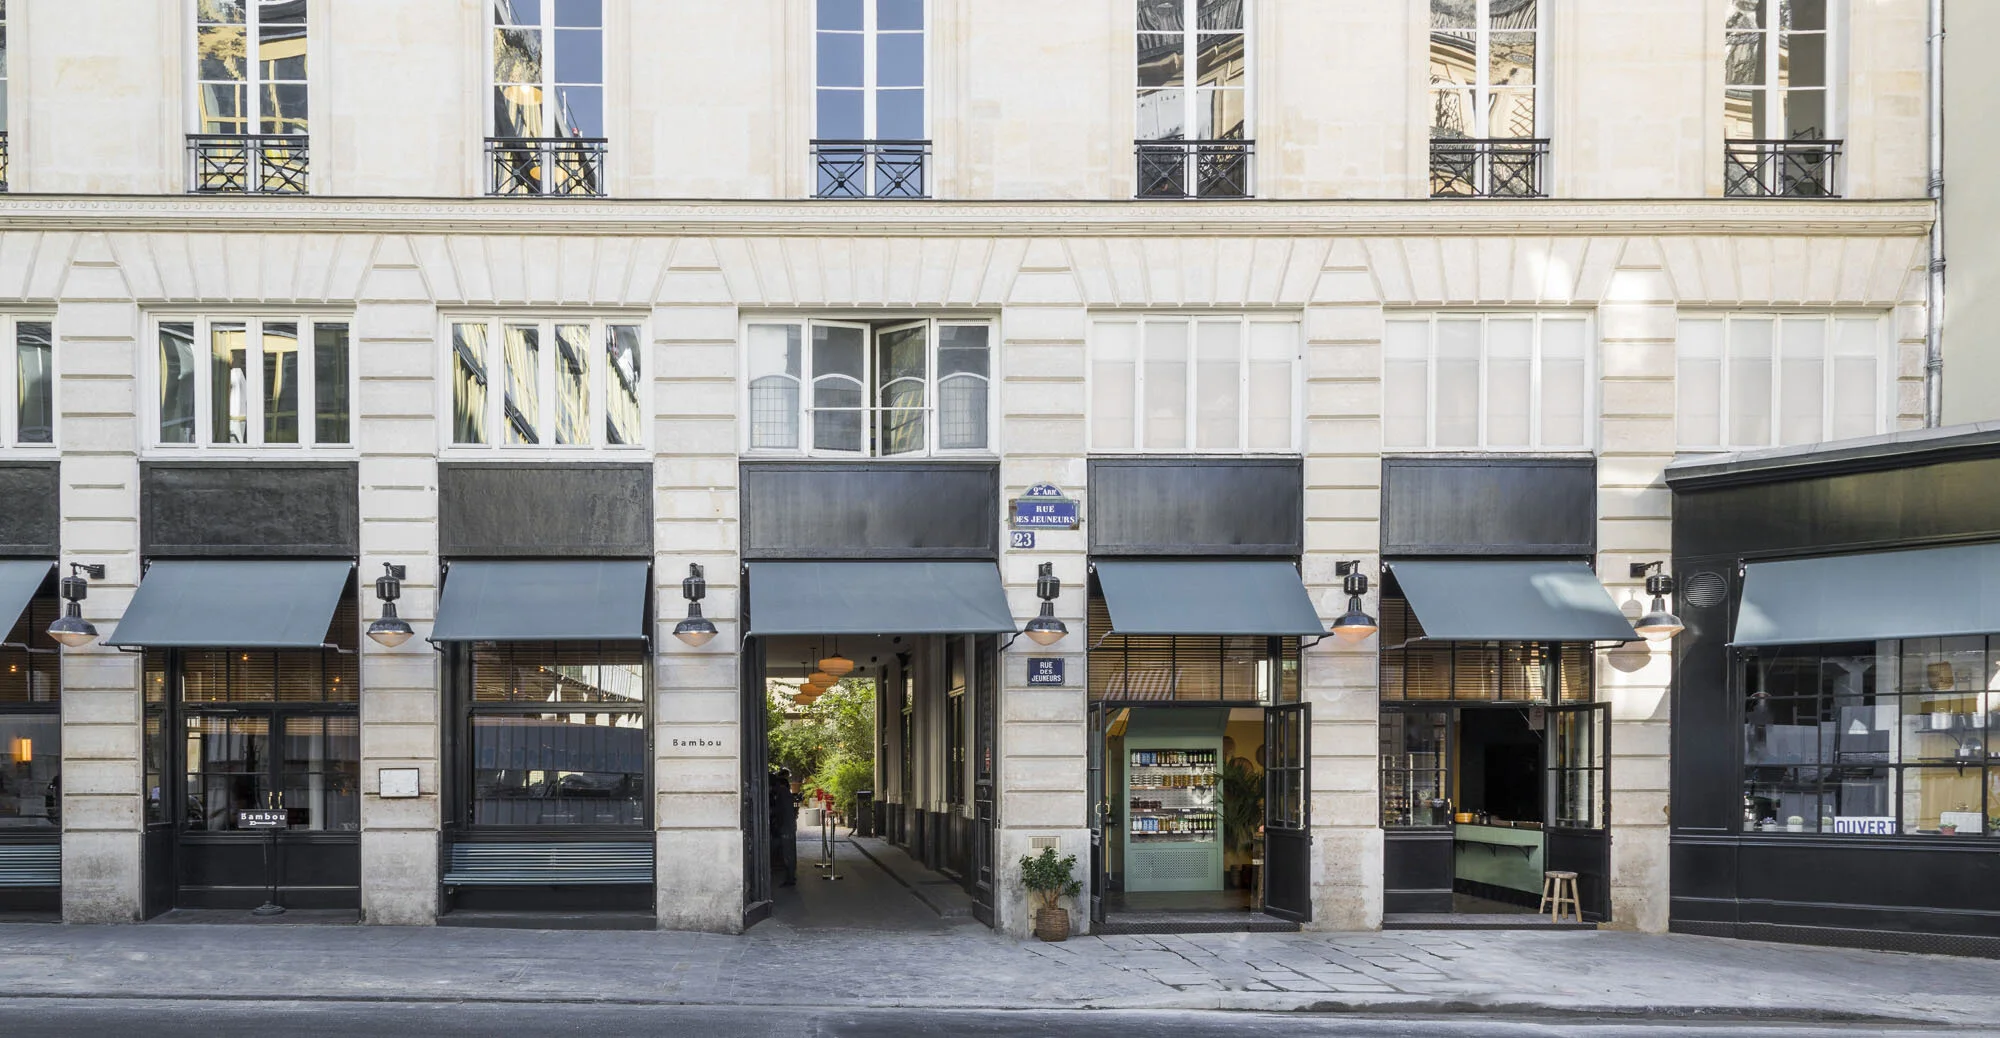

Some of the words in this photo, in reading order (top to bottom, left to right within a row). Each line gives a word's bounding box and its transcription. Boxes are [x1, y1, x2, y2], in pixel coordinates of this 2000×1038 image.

[1036, 505, 1055, 513] RUE
[1014, 533, 1032, 547] 23
[672, 738, 722, 747] Bambou
[241, 812, 286, 820] Bambou
[1836, 820, 1896, 834] OUVERT
